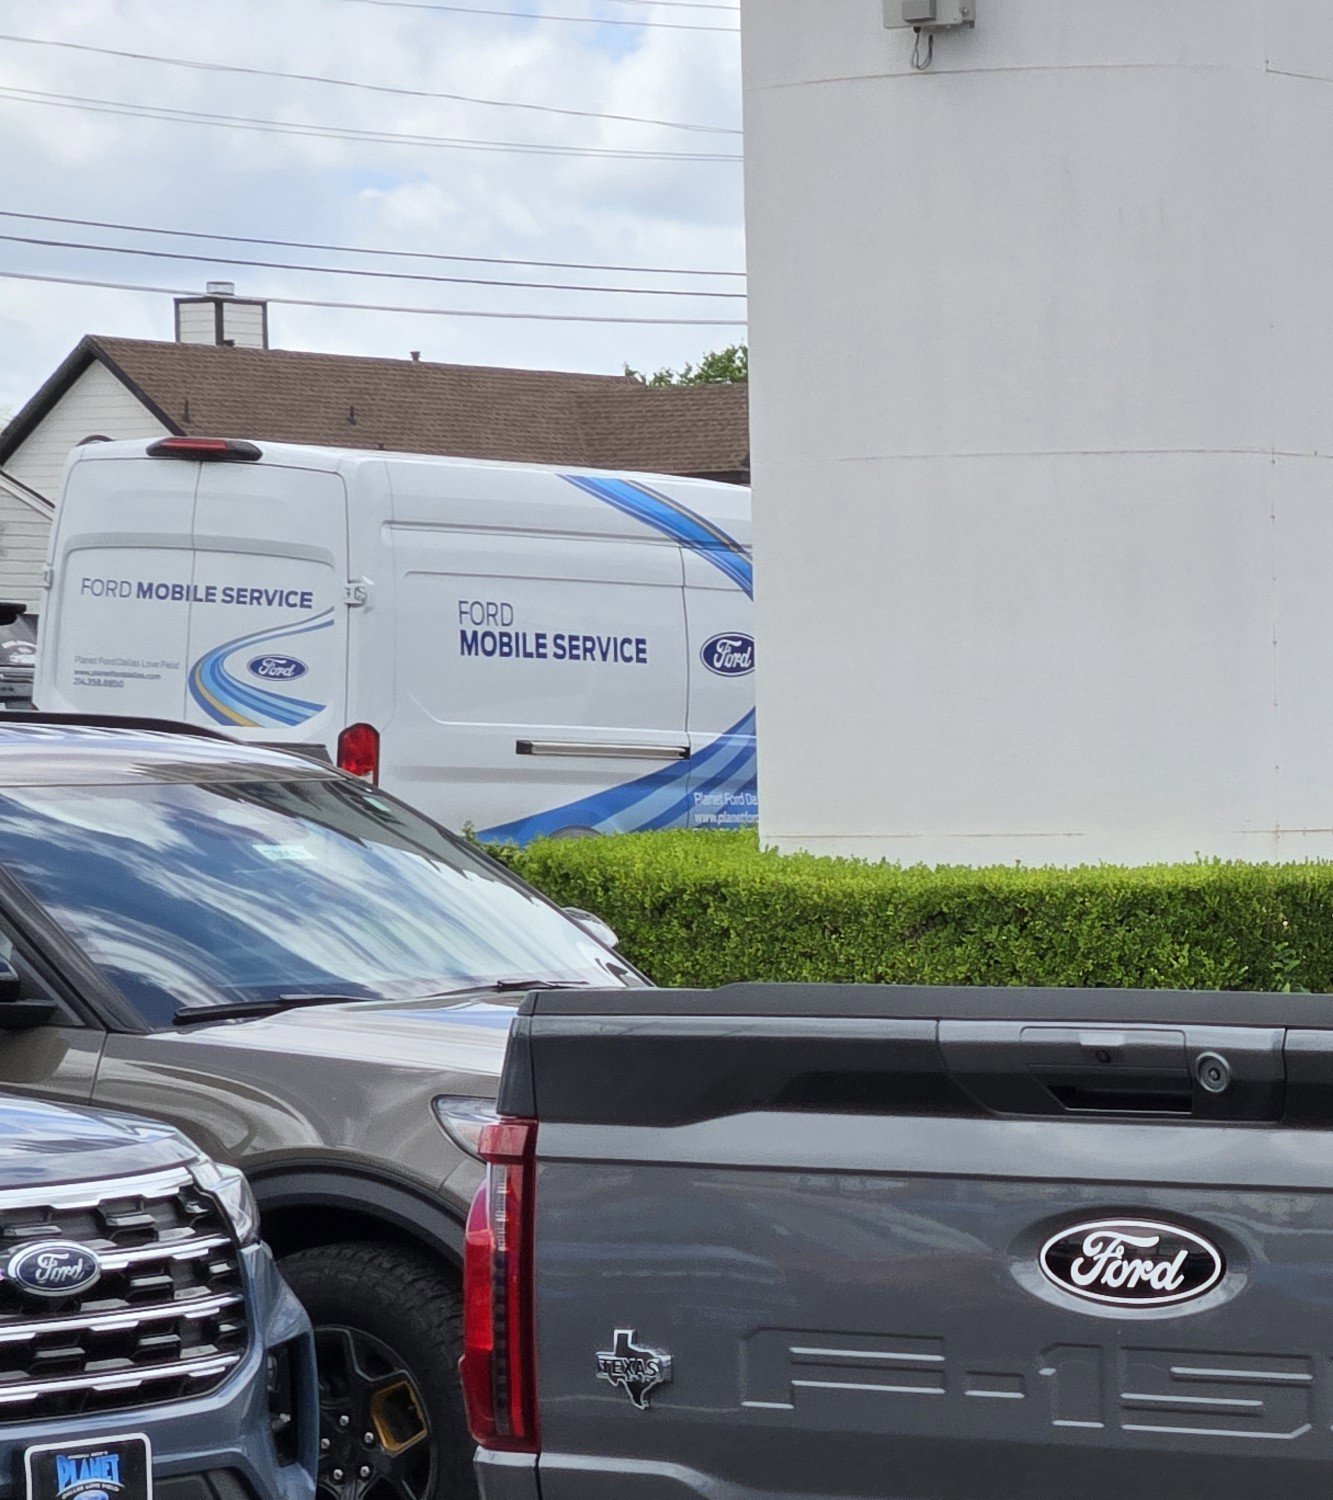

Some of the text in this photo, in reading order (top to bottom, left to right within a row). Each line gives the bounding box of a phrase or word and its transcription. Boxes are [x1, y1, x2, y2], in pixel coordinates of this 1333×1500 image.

[80, 577, 313, 609] FORD MOBILE SERVICE
[458, 600, 514, 627] FORD
[460, 629, 647, 664] MOBILE SERVICE
[713, 639, 752, 668] Ford
[258, 657, 295, 677] Ford
[35, 1252, 84, 1284] Ford
[1070, 1230, 1189, 1291] Ford
[599, 1357, 659, 1377] TEXAS
[56, 1453, 120, 1494] PLANET
